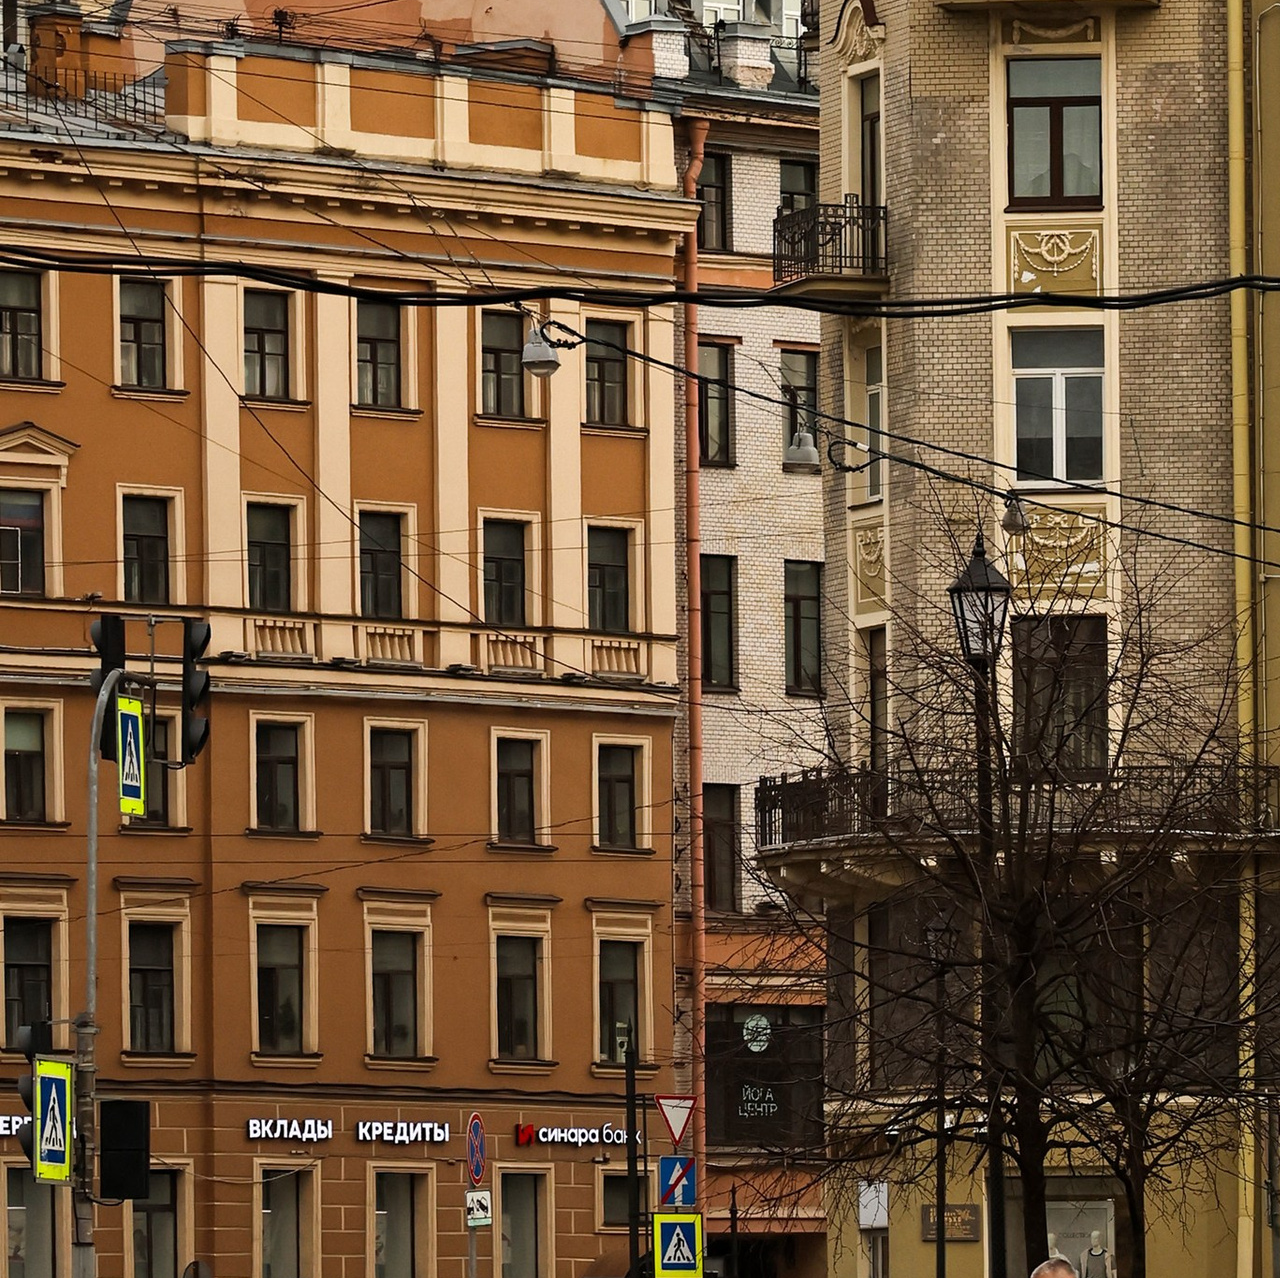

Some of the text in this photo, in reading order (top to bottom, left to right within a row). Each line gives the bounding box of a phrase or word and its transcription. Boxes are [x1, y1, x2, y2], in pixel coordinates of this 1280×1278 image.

[249, 1119, 450, 1145] ВКЛАДЫ КРЕДИТЫ
[538, 1126, 600, 1147] синара
